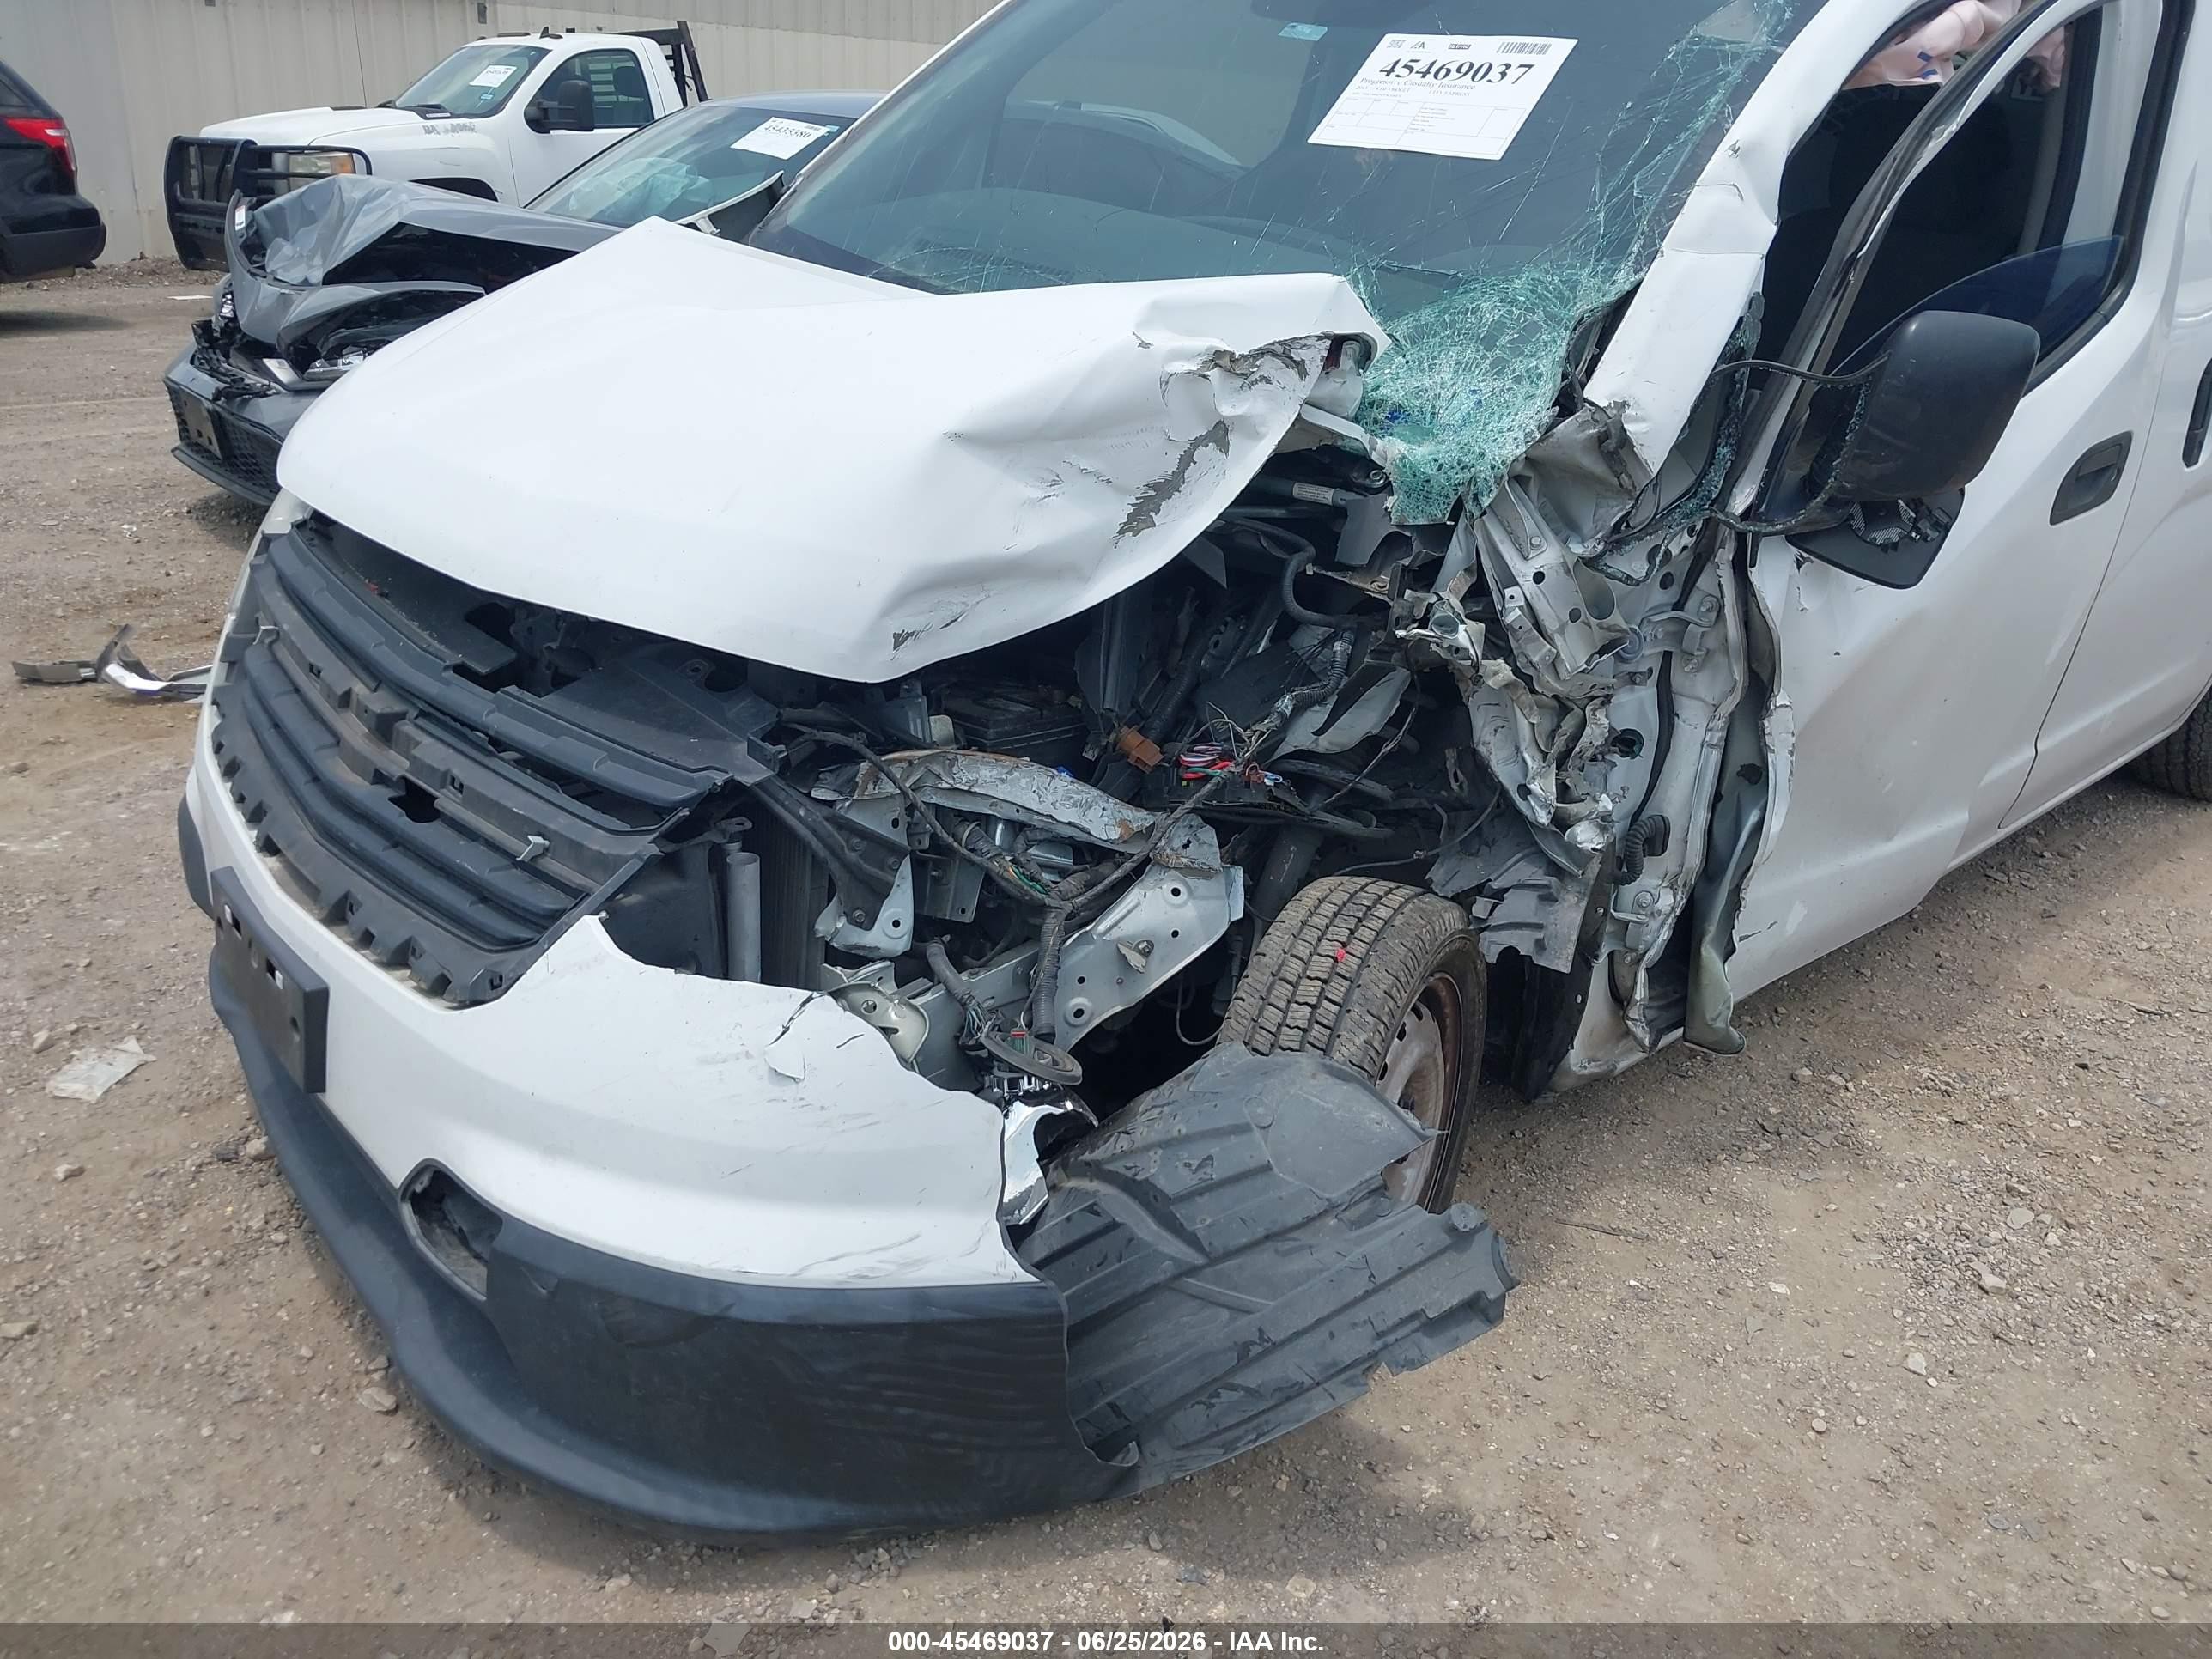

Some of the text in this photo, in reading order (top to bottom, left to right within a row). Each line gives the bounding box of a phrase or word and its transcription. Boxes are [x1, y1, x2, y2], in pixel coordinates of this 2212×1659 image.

[1379, 58, 1535, 84] 45469037
[1360, 77, 1476, 90] Progressive Casualty Insurance
